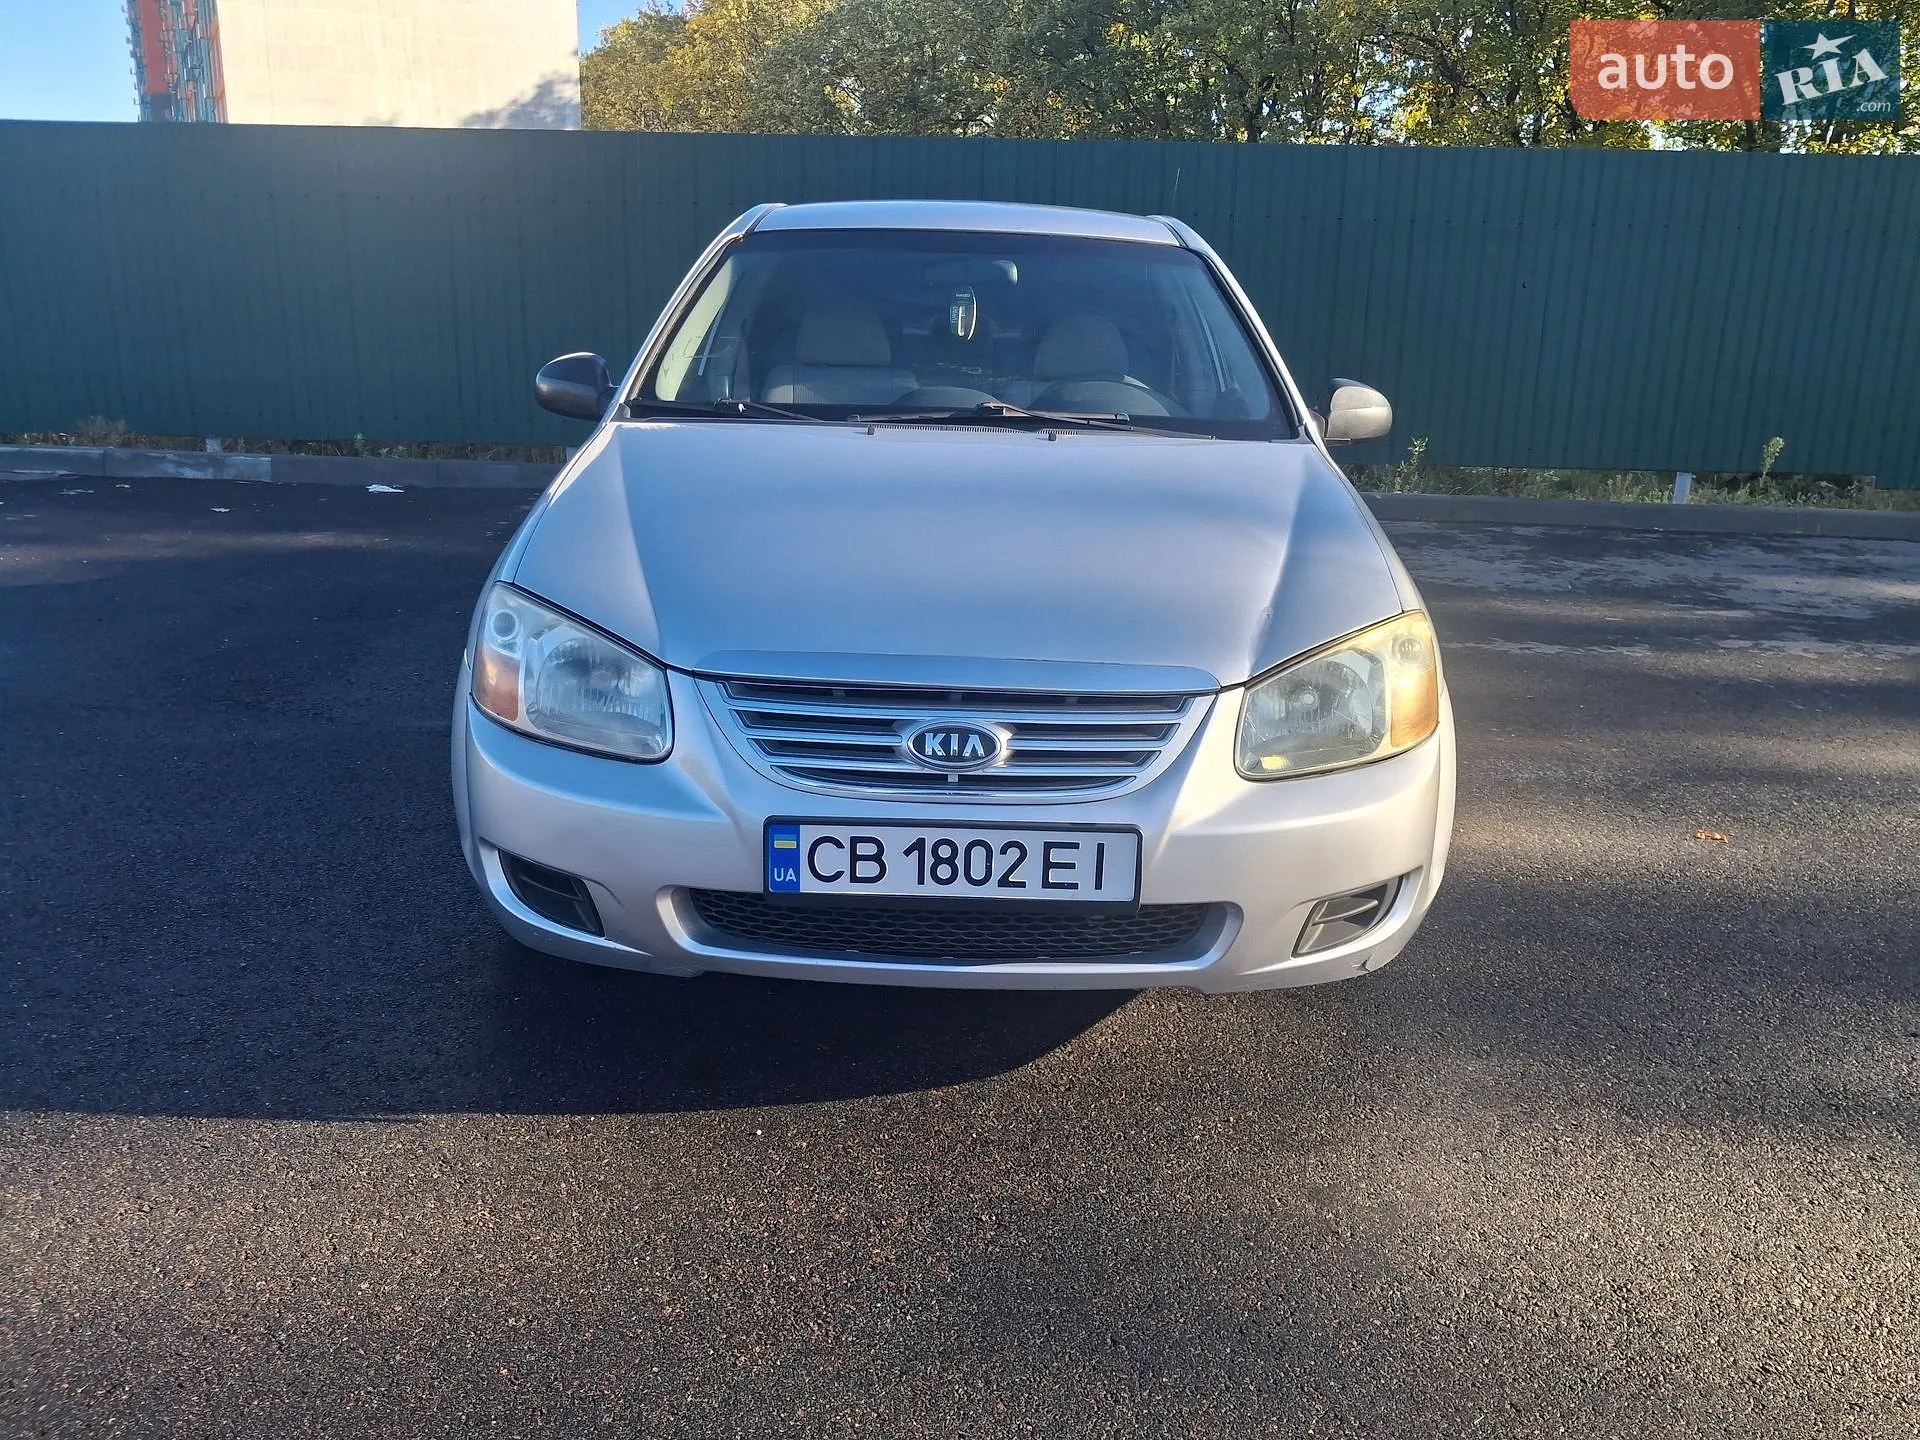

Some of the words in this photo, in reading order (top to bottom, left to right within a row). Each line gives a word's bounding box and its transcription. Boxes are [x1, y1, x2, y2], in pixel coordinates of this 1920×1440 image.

[925, 733, 985, 757] KIA
[774, 868, 796, 882] UA
[807, 836, 887, 884] CB
[903, 837, 1027, 888] 1802
[1042, 841, 1104, 890] EI
